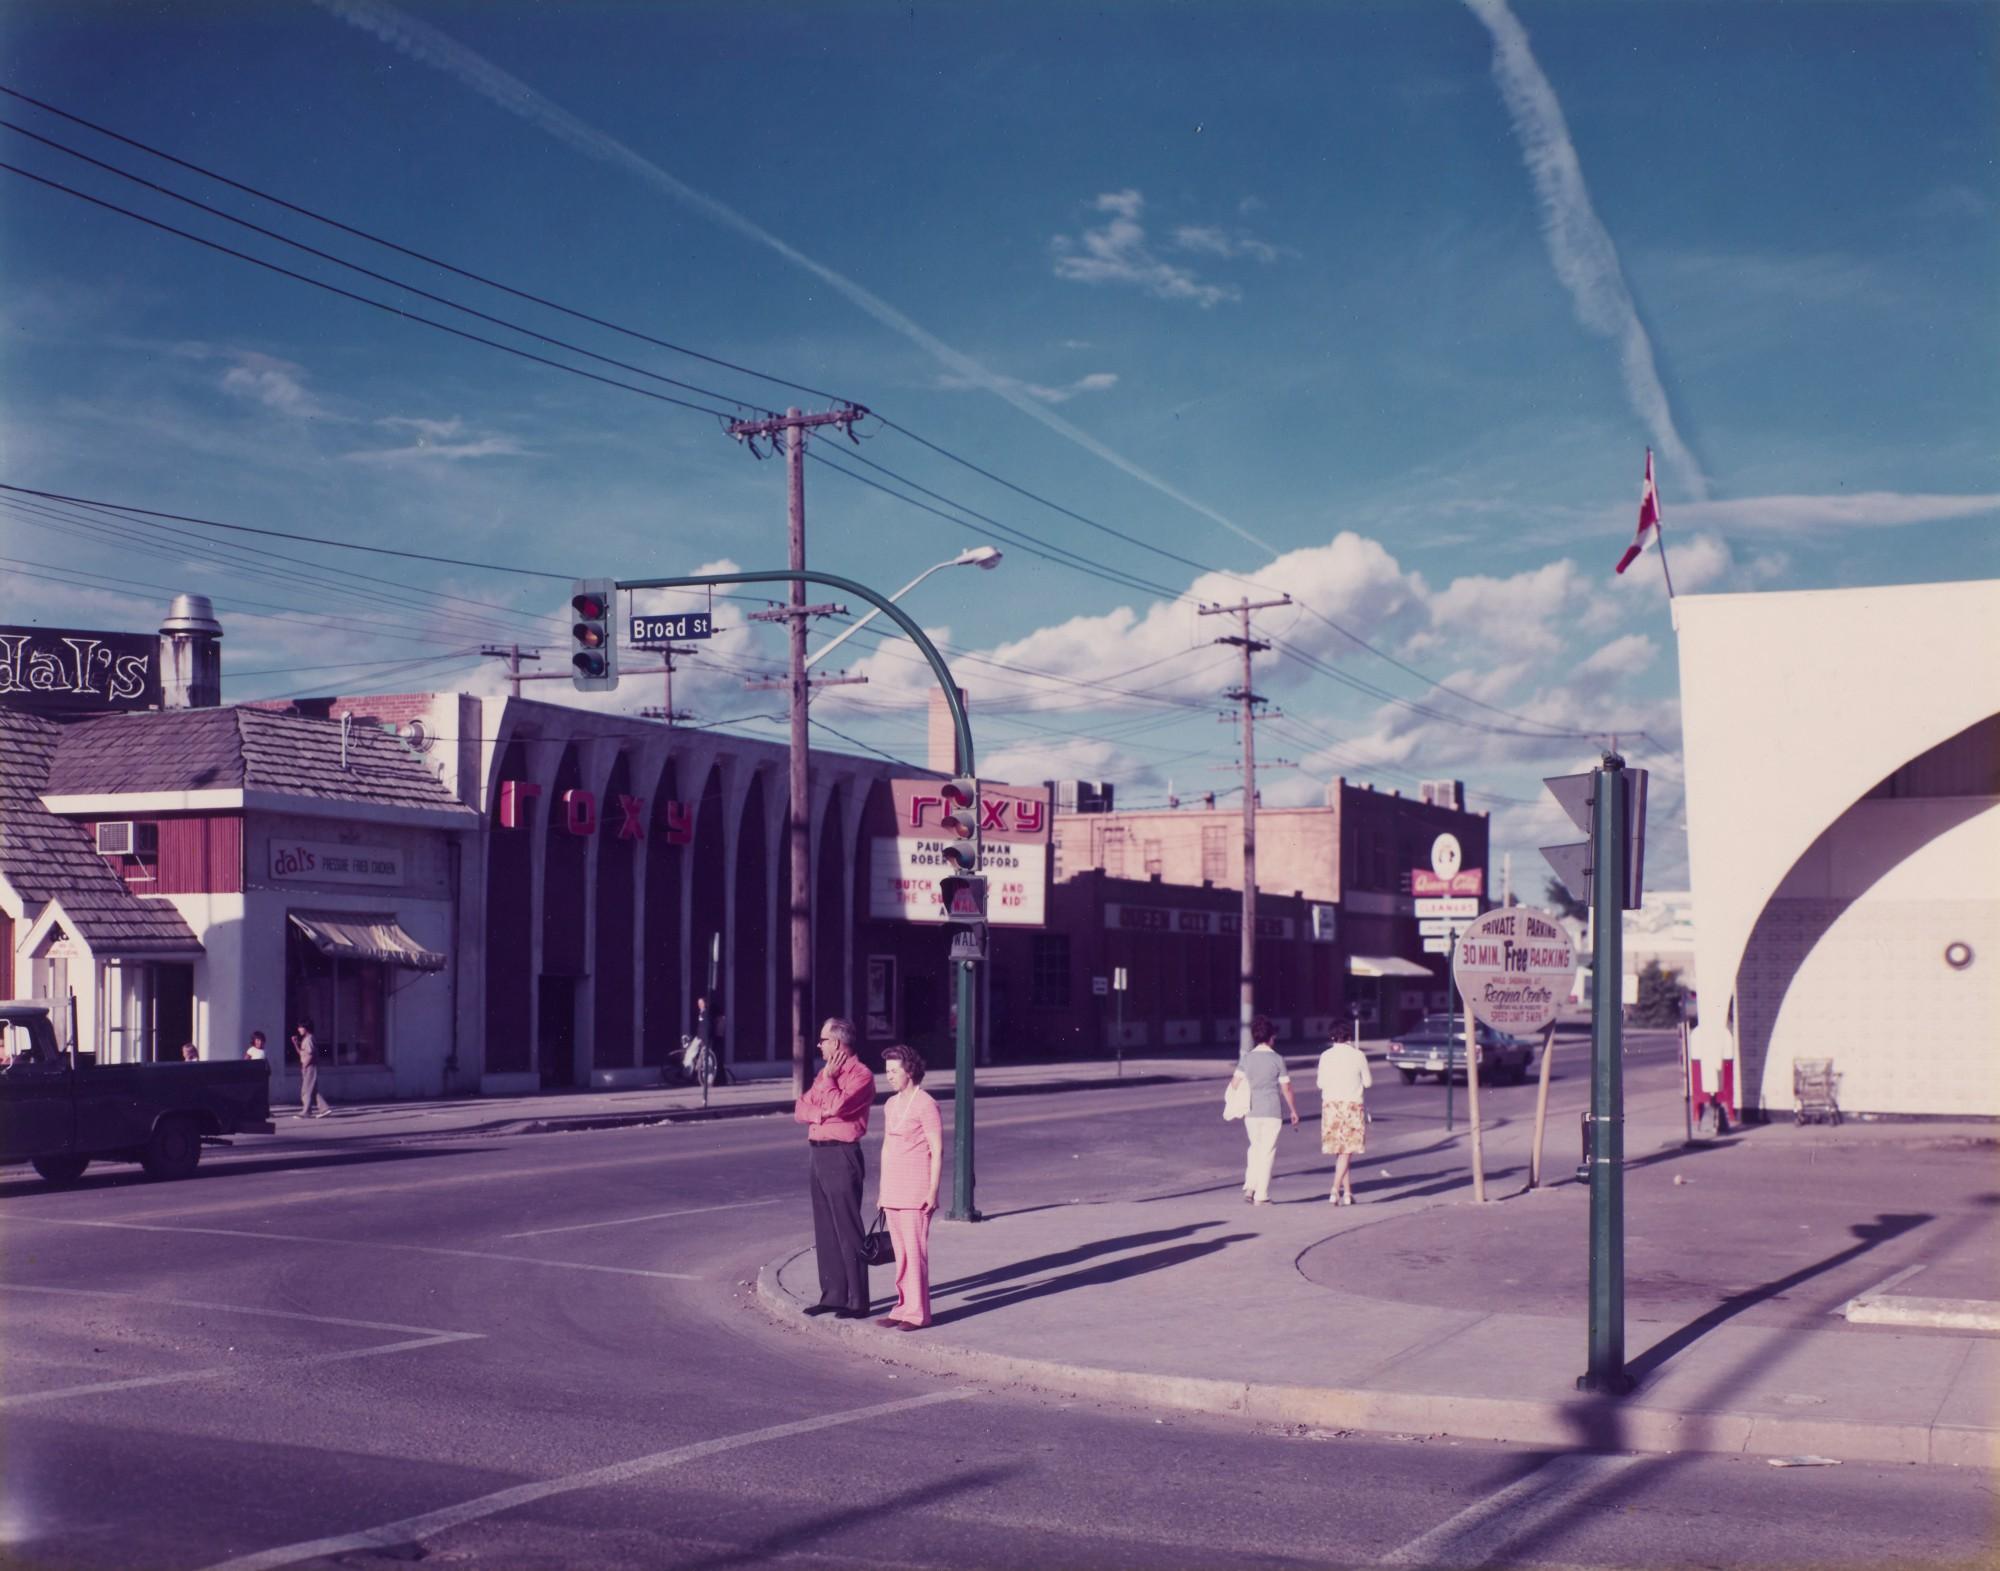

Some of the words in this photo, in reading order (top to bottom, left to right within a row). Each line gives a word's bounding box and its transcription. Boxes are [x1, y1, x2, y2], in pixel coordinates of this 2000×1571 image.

[634, 617, 686, 639] Broad
[0, 634, 148, 701] dal's
[501, 780, 692, 845] roxy
[911, 796, 1044, 832] rxy
[917, 842, 944, 853] PAUL
[275, 847, 316, 875] dal's
[911, 855, 948, 865] ROBER
[982, 858, 1019, 868] DFORD
[896, 893, 918, 904] THE
[1002, 884, 1024, 893] AND
[954, 930, 977, 947] WAL
[1482, 917, 1515, 936] PRIVATE
[1527, 918, 1556, 939] PARKING
[1463, 944, 1476, 964] 30
[1479, 945, 1500, 966] MIN.
[1504, 940, 1528, 972] Free
[1530, 948, 1570, 968] PARKING
